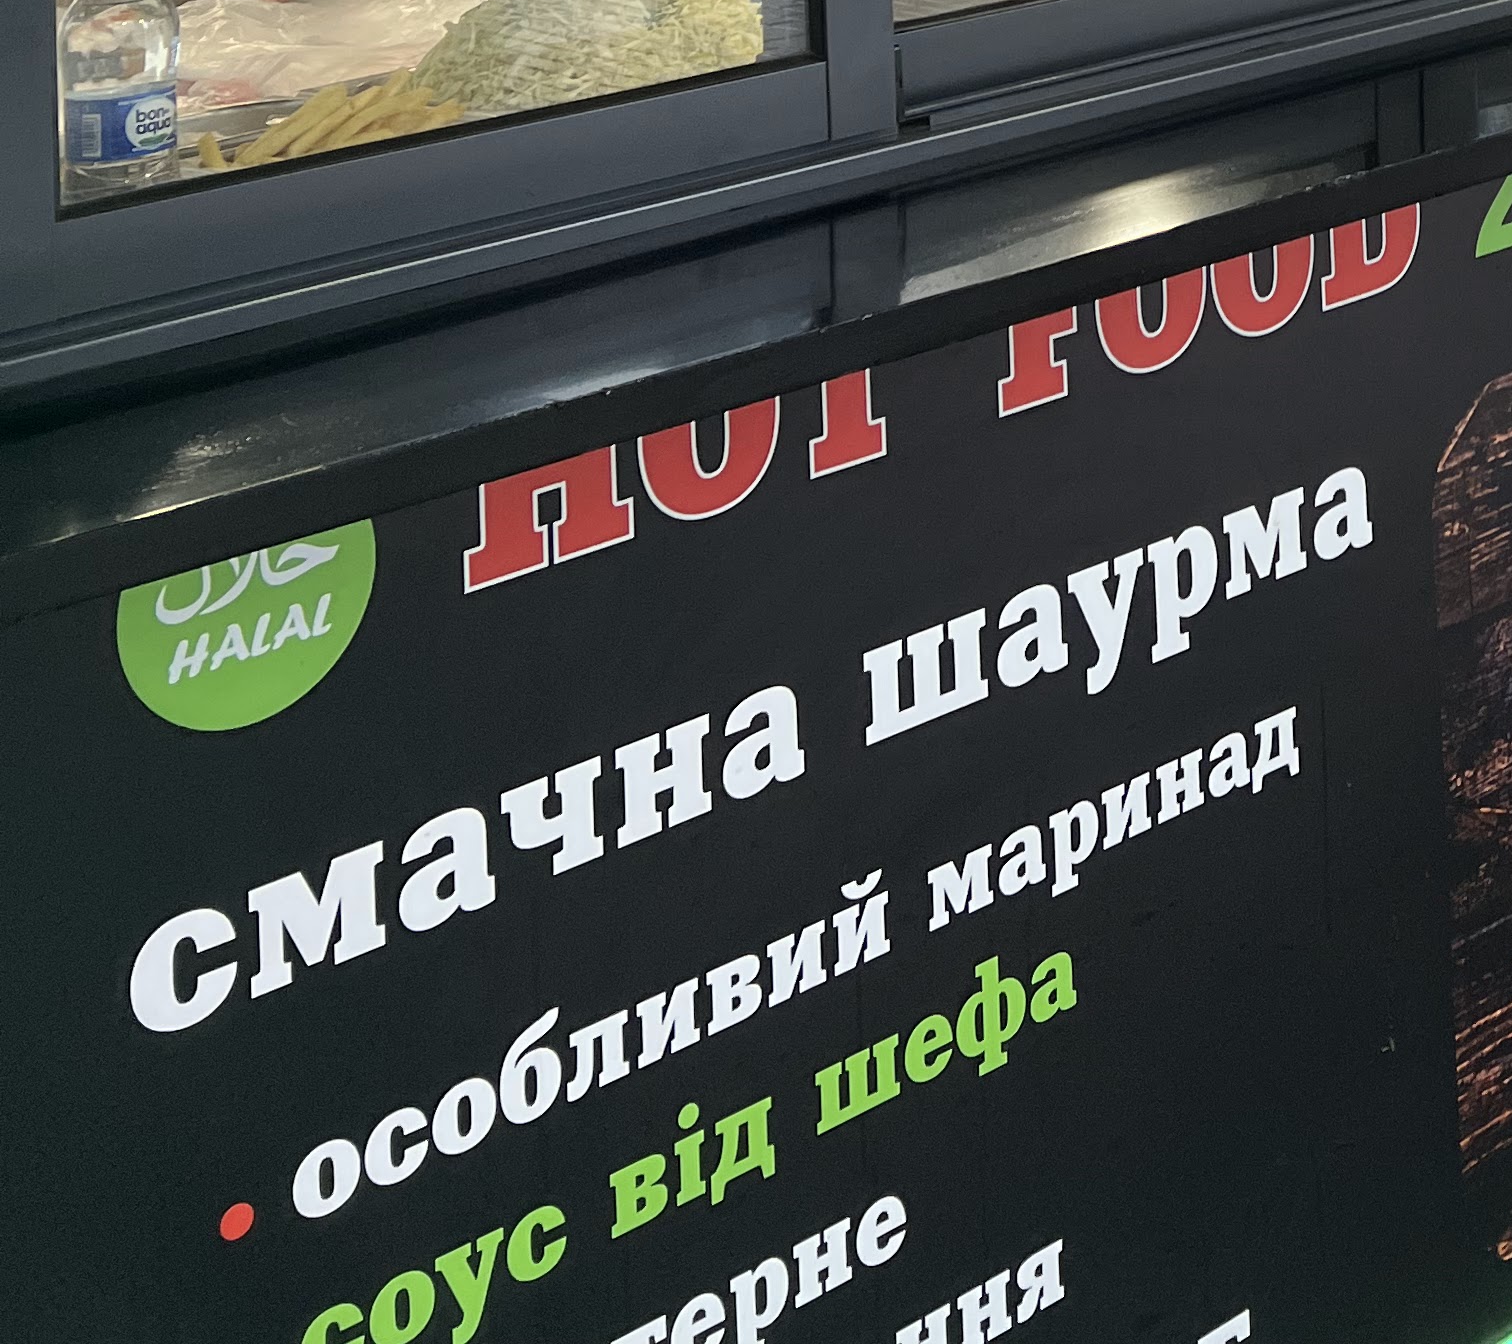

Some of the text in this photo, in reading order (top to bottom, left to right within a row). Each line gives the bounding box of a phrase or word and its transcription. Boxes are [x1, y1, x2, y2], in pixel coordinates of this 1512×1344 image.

[136, 117, 171, 134] aqua
[130, 466, 1373, 1032] смачна шаурма
[168, 593, 332, 684] HALAL
[293, 706, 1300, 1218] особливий маринад
[300, 951, 1077, 1344] соус від шефа
